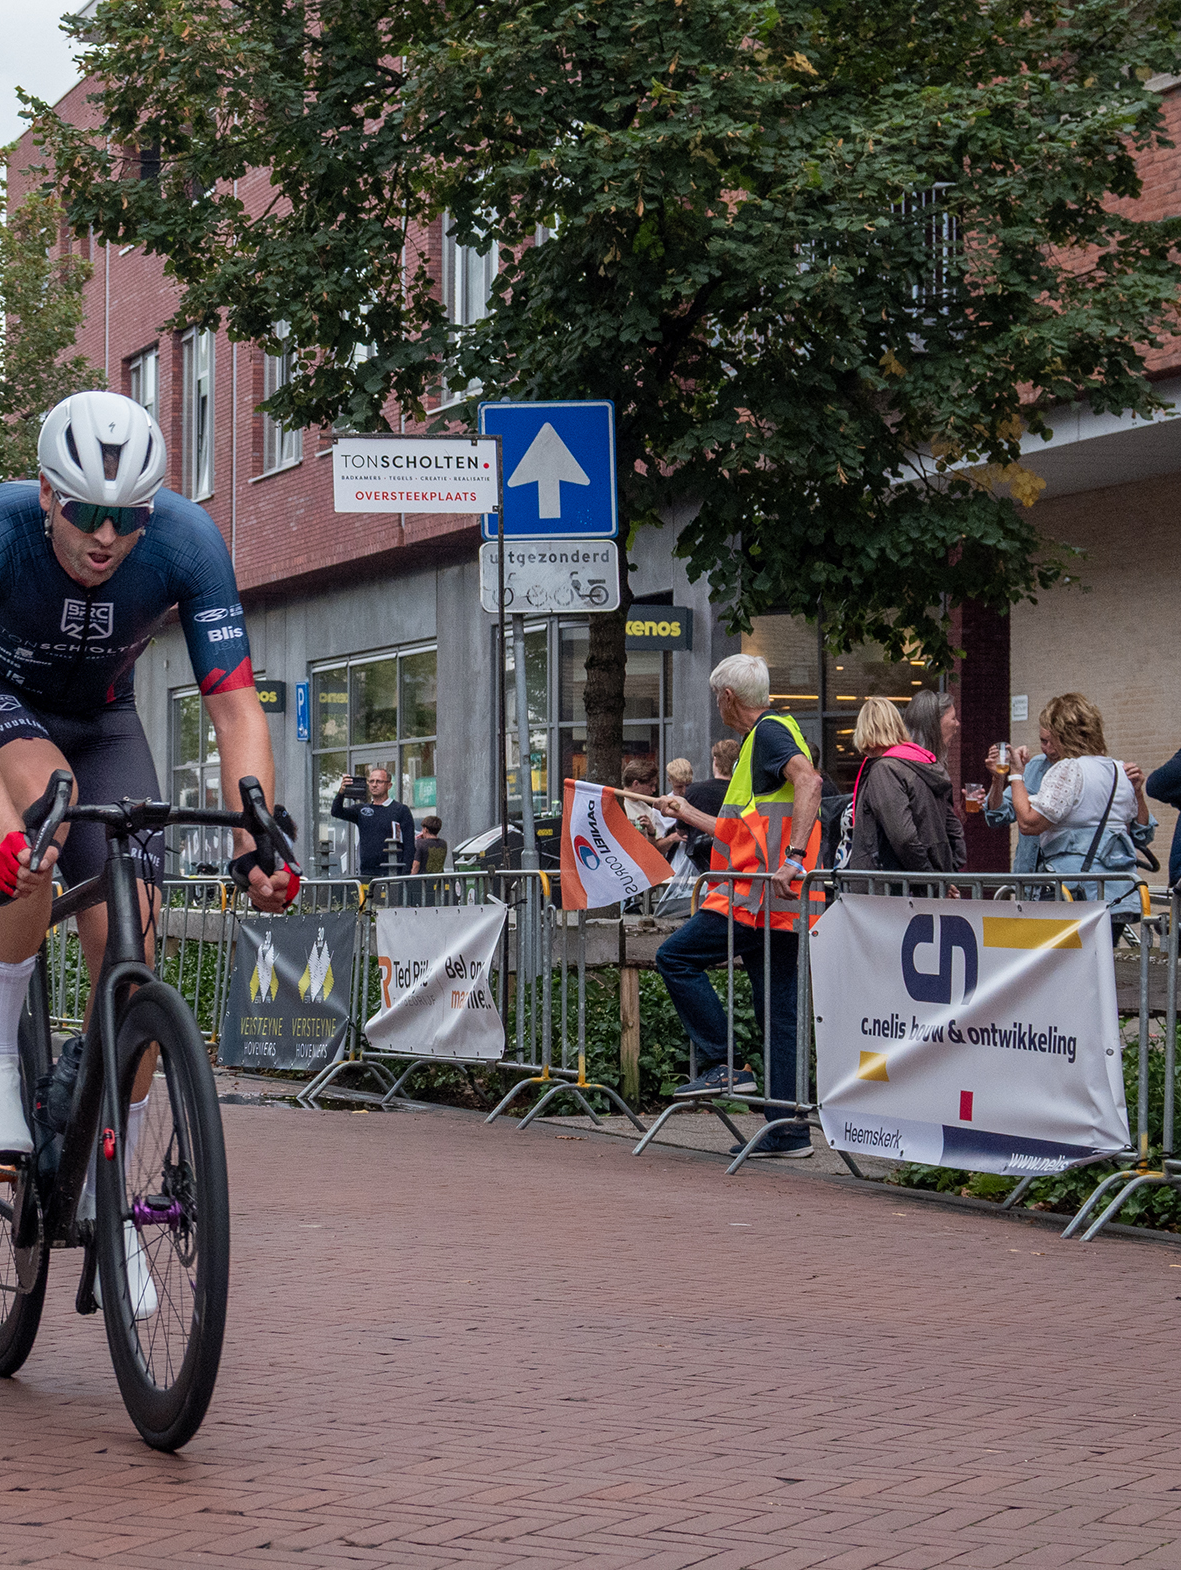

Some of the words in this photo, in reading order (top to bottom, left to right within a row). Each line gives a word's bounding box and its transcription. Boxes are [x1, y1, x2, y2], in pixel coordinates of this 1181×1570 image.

[355, 491, 477, 502] OVERSTEEKPLAATS
[489, 549, 609, 567] utgezonderd
[207, 625, 244, 642] Blis
[393, 960, 411, 989] Ted
[445, 954, 467, 980] Bel
[291, 1018, 336, 1037] VERSTEYNE
[861, 1013, 906, 1039] c.nelis
[909, 1016, 944, 1043] bouw
[947, 1019, 967, 1044] &
[968, 1022, 1077, 1063] ontwikkeling
[844, 1122, 904, 1150] Heemskerk
